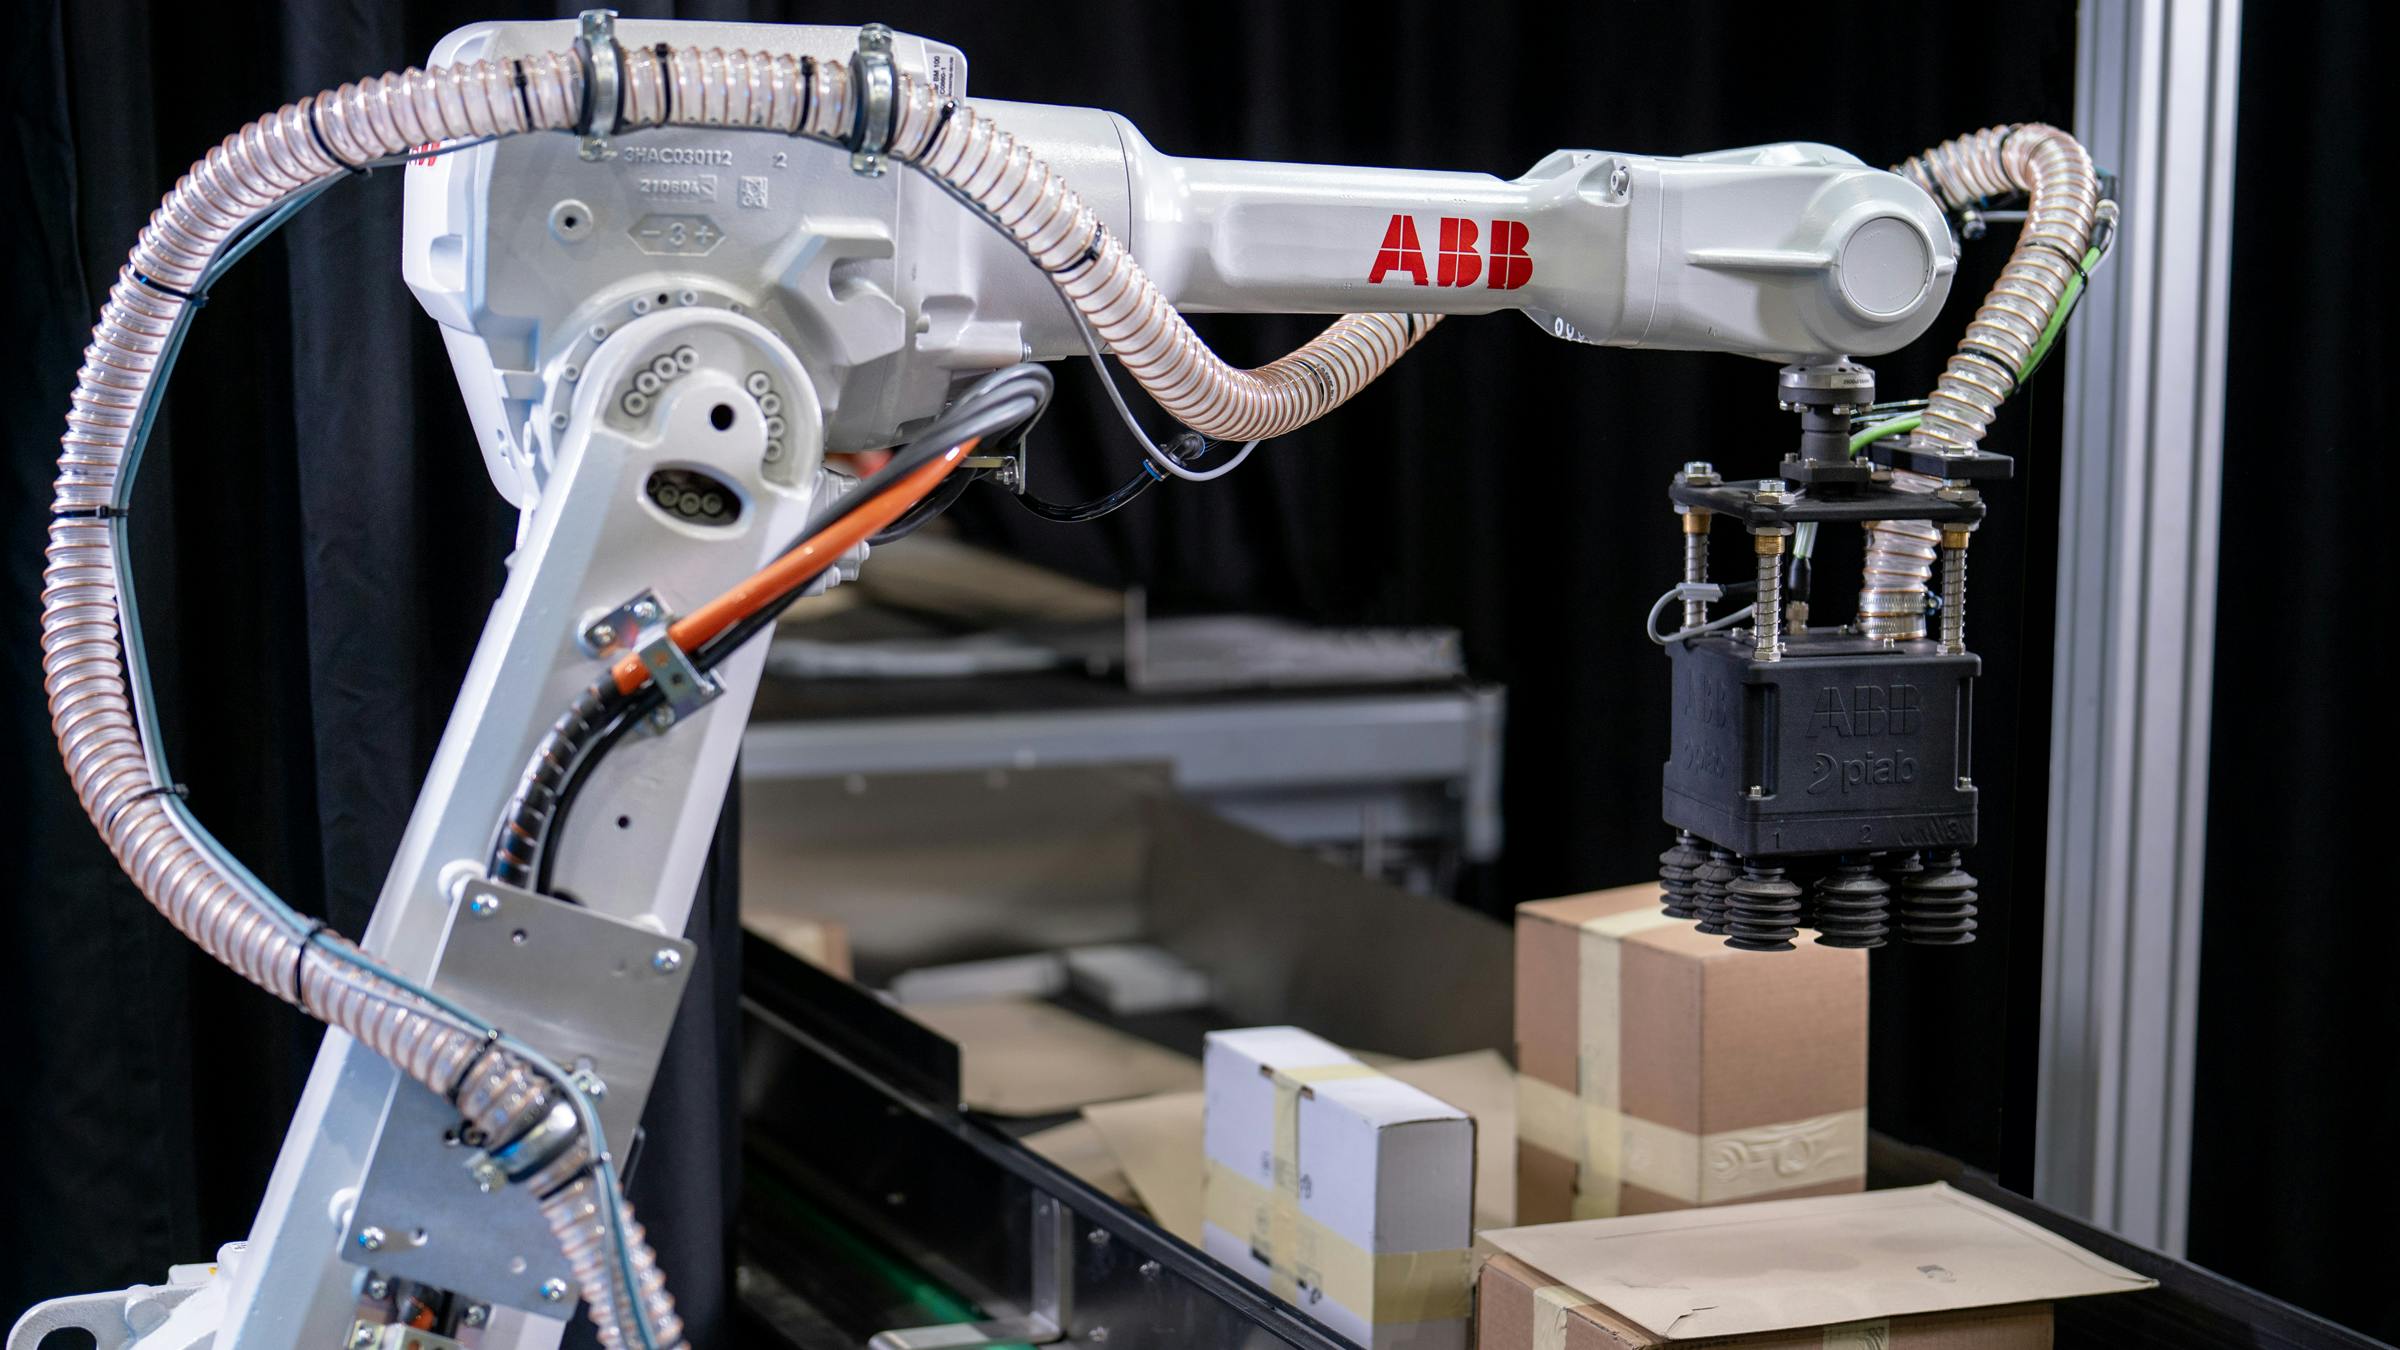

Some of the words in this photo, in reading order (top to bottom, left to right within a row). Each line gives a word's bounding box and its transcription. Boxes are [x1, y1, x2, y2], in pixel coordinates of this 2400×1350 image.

[623, 146, 733, 167] 3HAC030112
[1368, 214, 1534, 290] ABB
[1805, 684, 1923, 738] ABB
[1841, 749, 1920, 793] piab
[1859, 824, 1873, 845] 2
